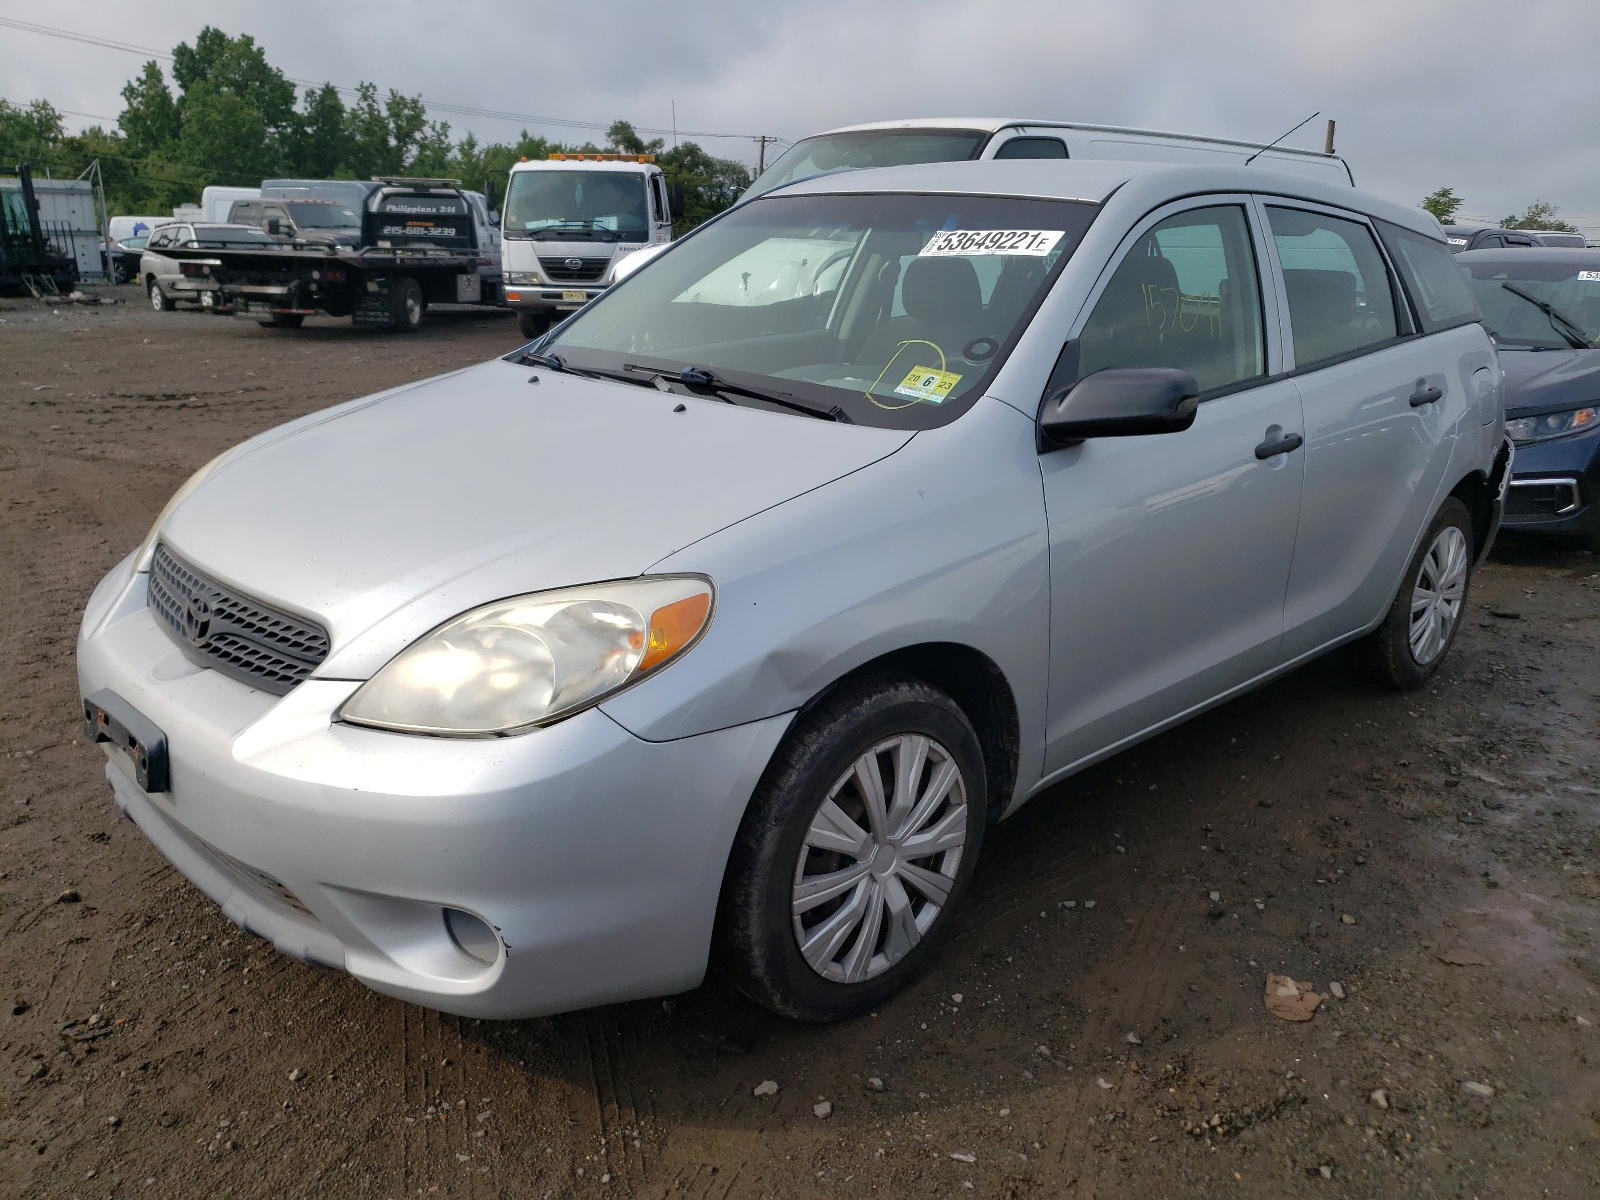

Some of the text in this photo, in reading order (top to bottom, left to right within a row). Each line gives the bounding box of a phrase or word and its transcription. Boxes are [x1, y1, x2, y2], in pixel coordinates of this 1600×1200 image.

[385, 205, 456, 213] Philippians 3:14
[937, 232, 1042, 250] 53649221
[907, 374, 953, 390] 20 6 23
